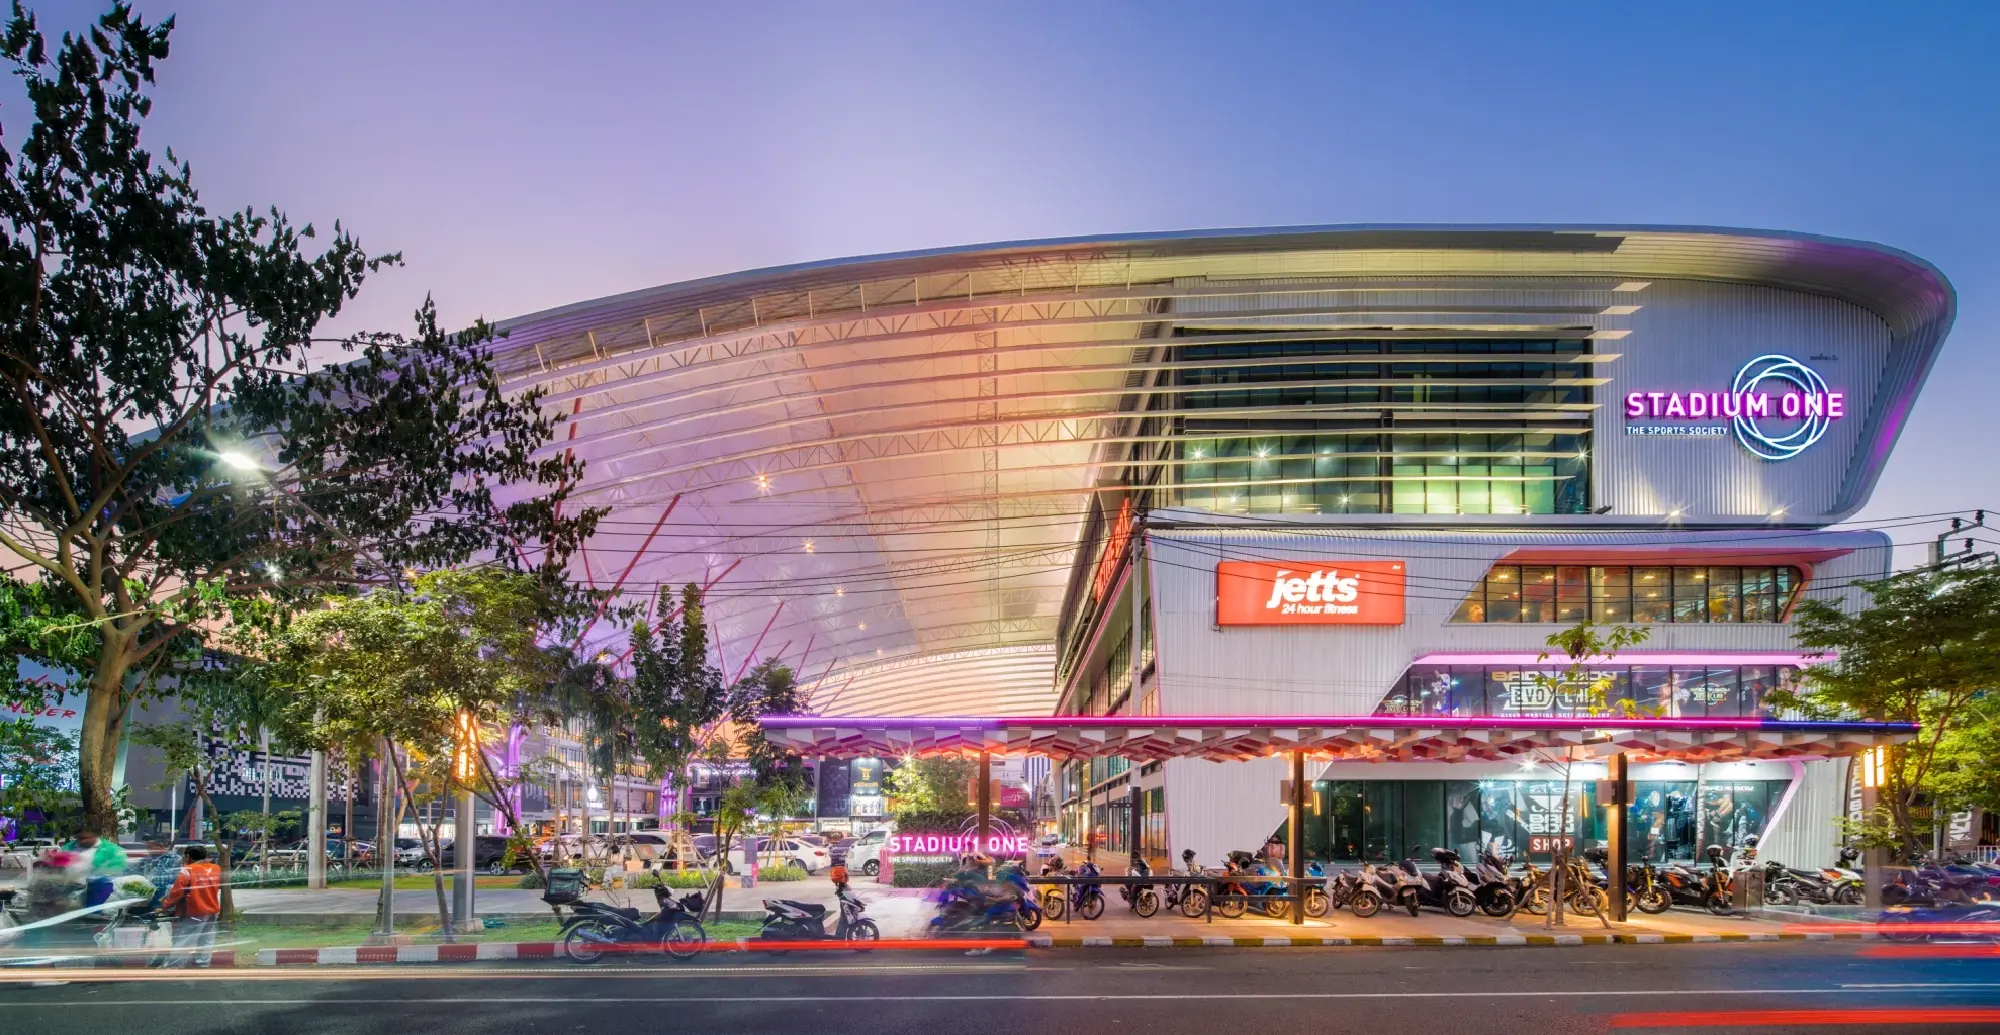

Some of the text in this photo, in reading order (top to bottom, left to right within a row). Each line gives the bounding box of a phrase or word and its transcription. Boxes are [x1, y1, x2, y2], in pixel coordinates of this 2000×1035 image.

[1627, 392, 1844, 417] STADIUM ONE
[1626, 426, 1728, 435] THE SPORTS SOCIETY
[1266, 569, 1360, 608] jetts
[1281, 603, 1359, 614] 24 hour fitness
[1492, 671, 1541, 681] BAD
[1514, 688, 1545, 702] EVO
[889, 836, 1029, 852] STADIUM ONE
